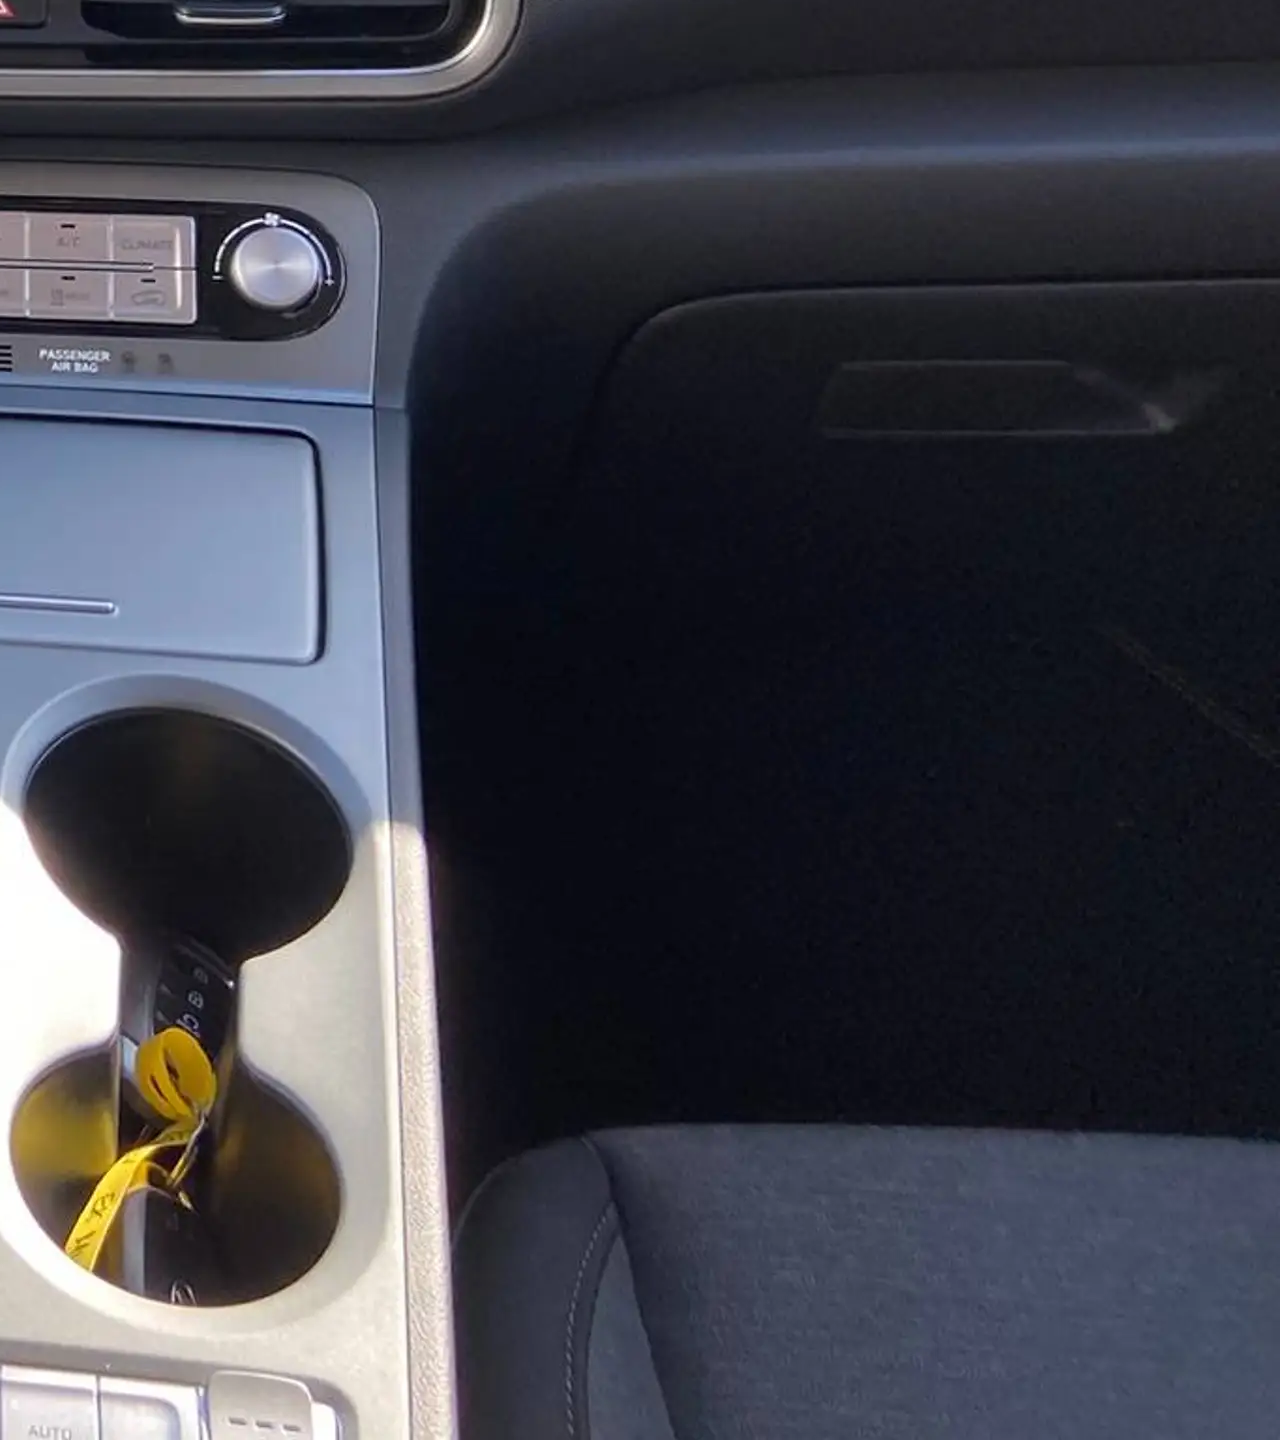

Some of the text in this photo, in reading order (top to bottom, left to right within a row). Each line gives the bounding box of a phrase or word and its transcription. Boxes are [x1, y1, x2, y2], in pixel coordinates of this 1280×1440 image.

[38, 348, 111, 362] PASSENGER
[51, 362, 99, 373] AIR BAG
[27, 1424, 72, 1440] AUTO
